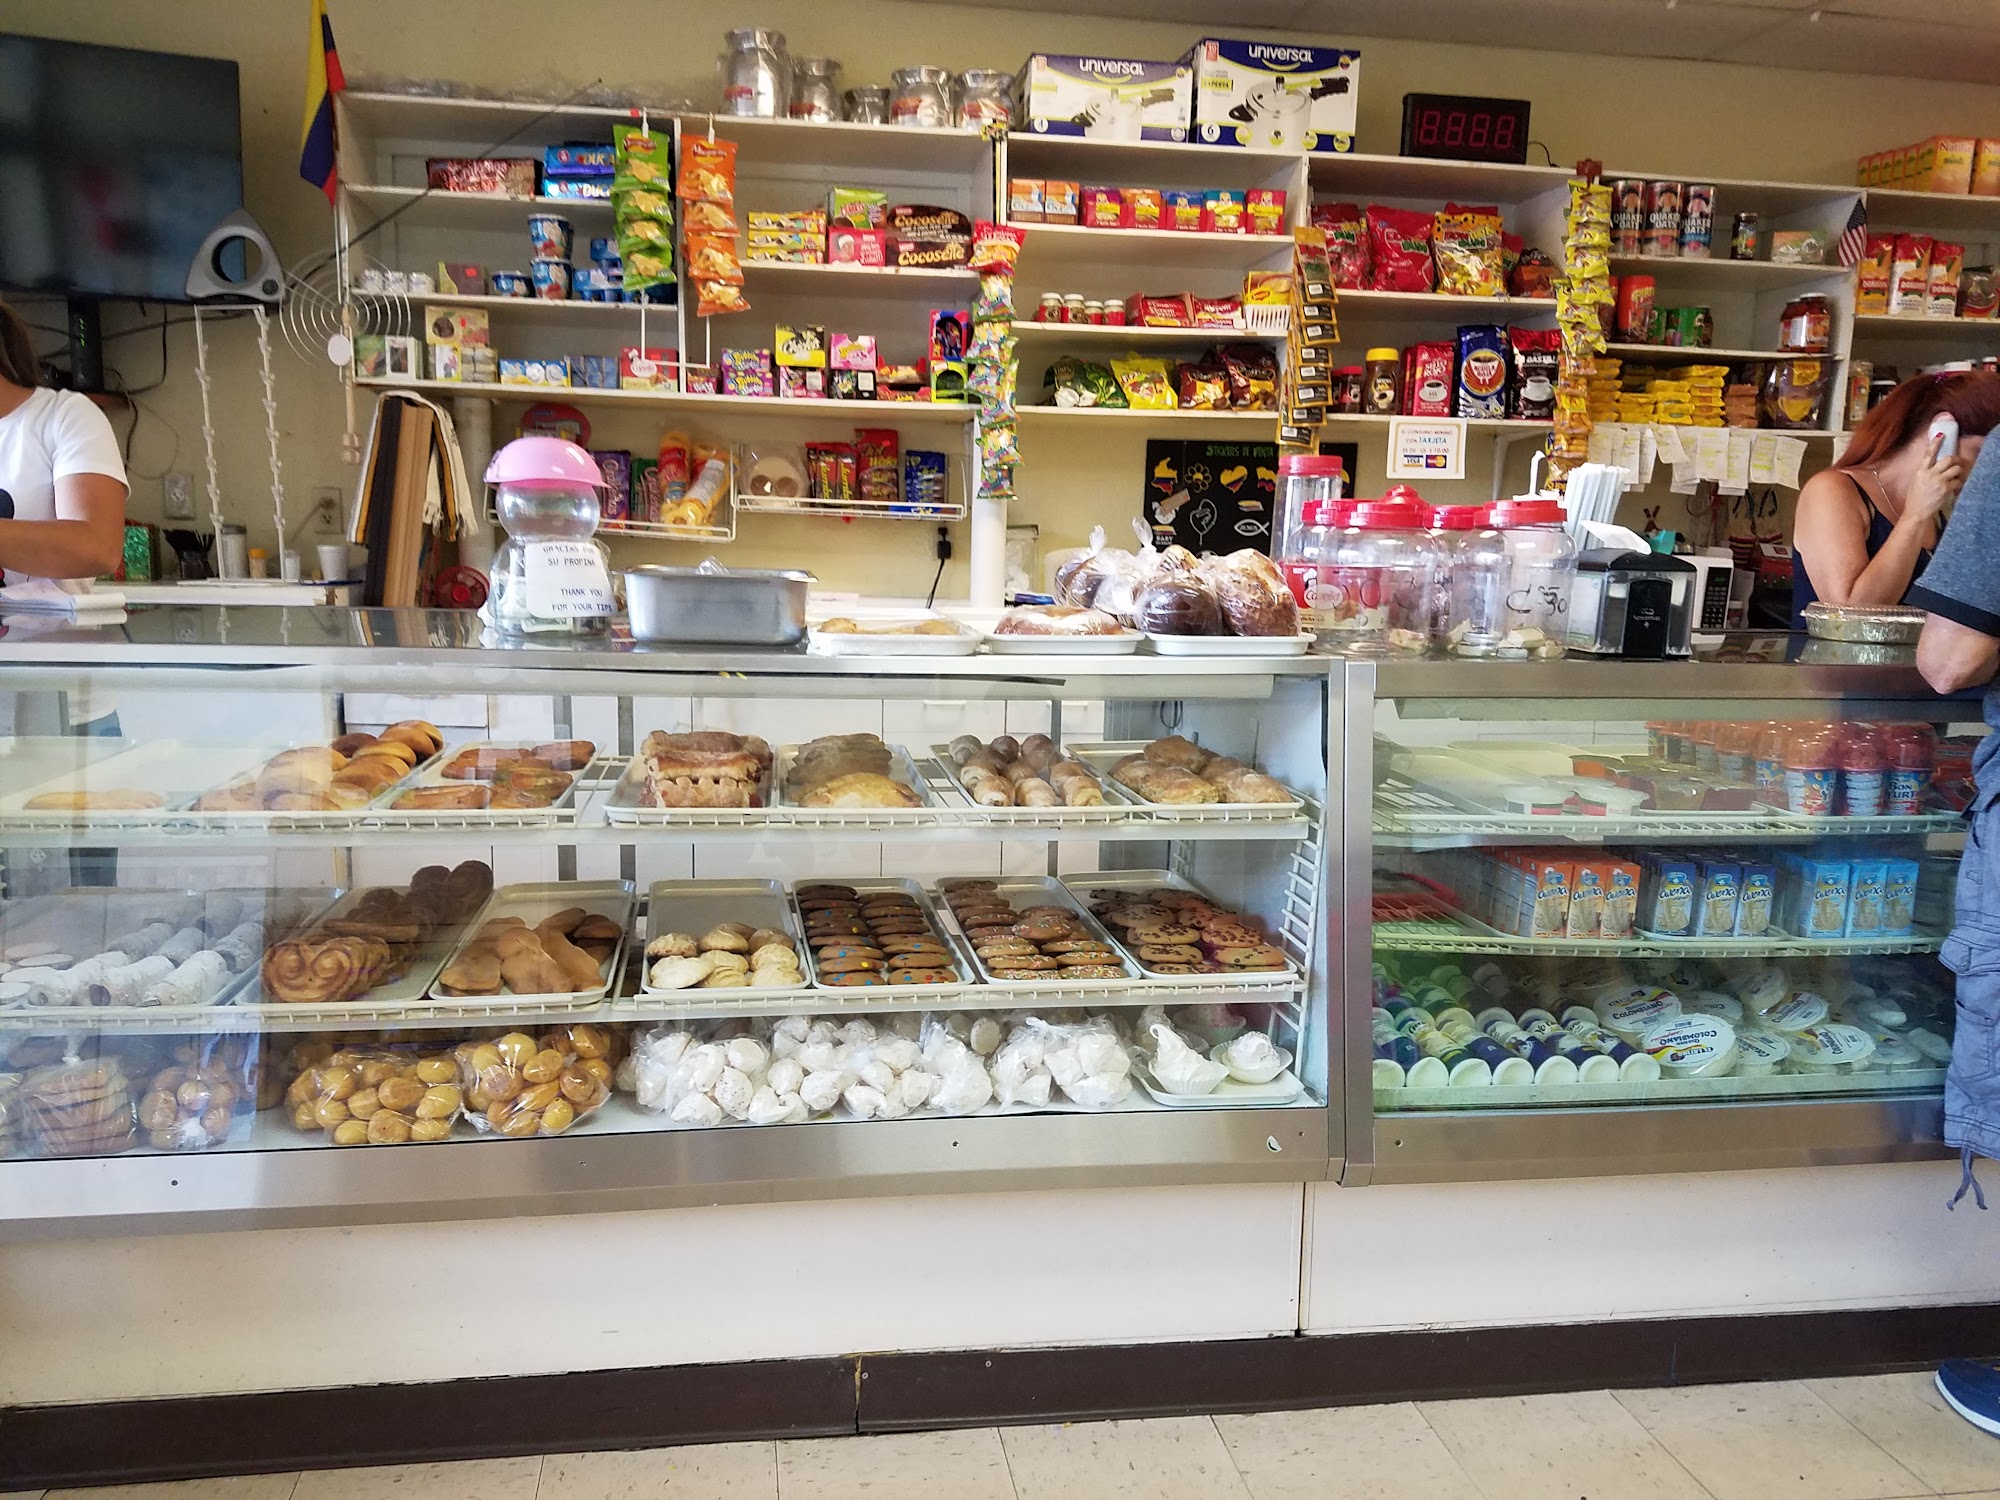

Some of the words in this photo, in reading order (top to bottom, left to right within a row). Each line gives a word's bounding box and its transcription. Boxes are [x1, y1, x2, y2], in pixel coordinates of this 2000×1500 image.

[1249, 44, 1314, 63] universal
[1079, 57, 1144, 76] universal
[1620, 220, 1639, 230] OATS
[1655, 220, 1677, 229] OATS
[1684, 226, 1706, 235] OATS
[898, 241, 965, 266] Cocosette
[563, 558, 597, 567] PROPINA
[561, 588, 586, 596] THANK
[589, 588, 603, 597] YOU
[573, 603, 593, 611] YOUR
[596, 604, 613, 612] TIPS
[1612, 1000, 1664, 1020] COLOMBIANO
[1659, 1029, 1717, 1046] COLOMBIANO
